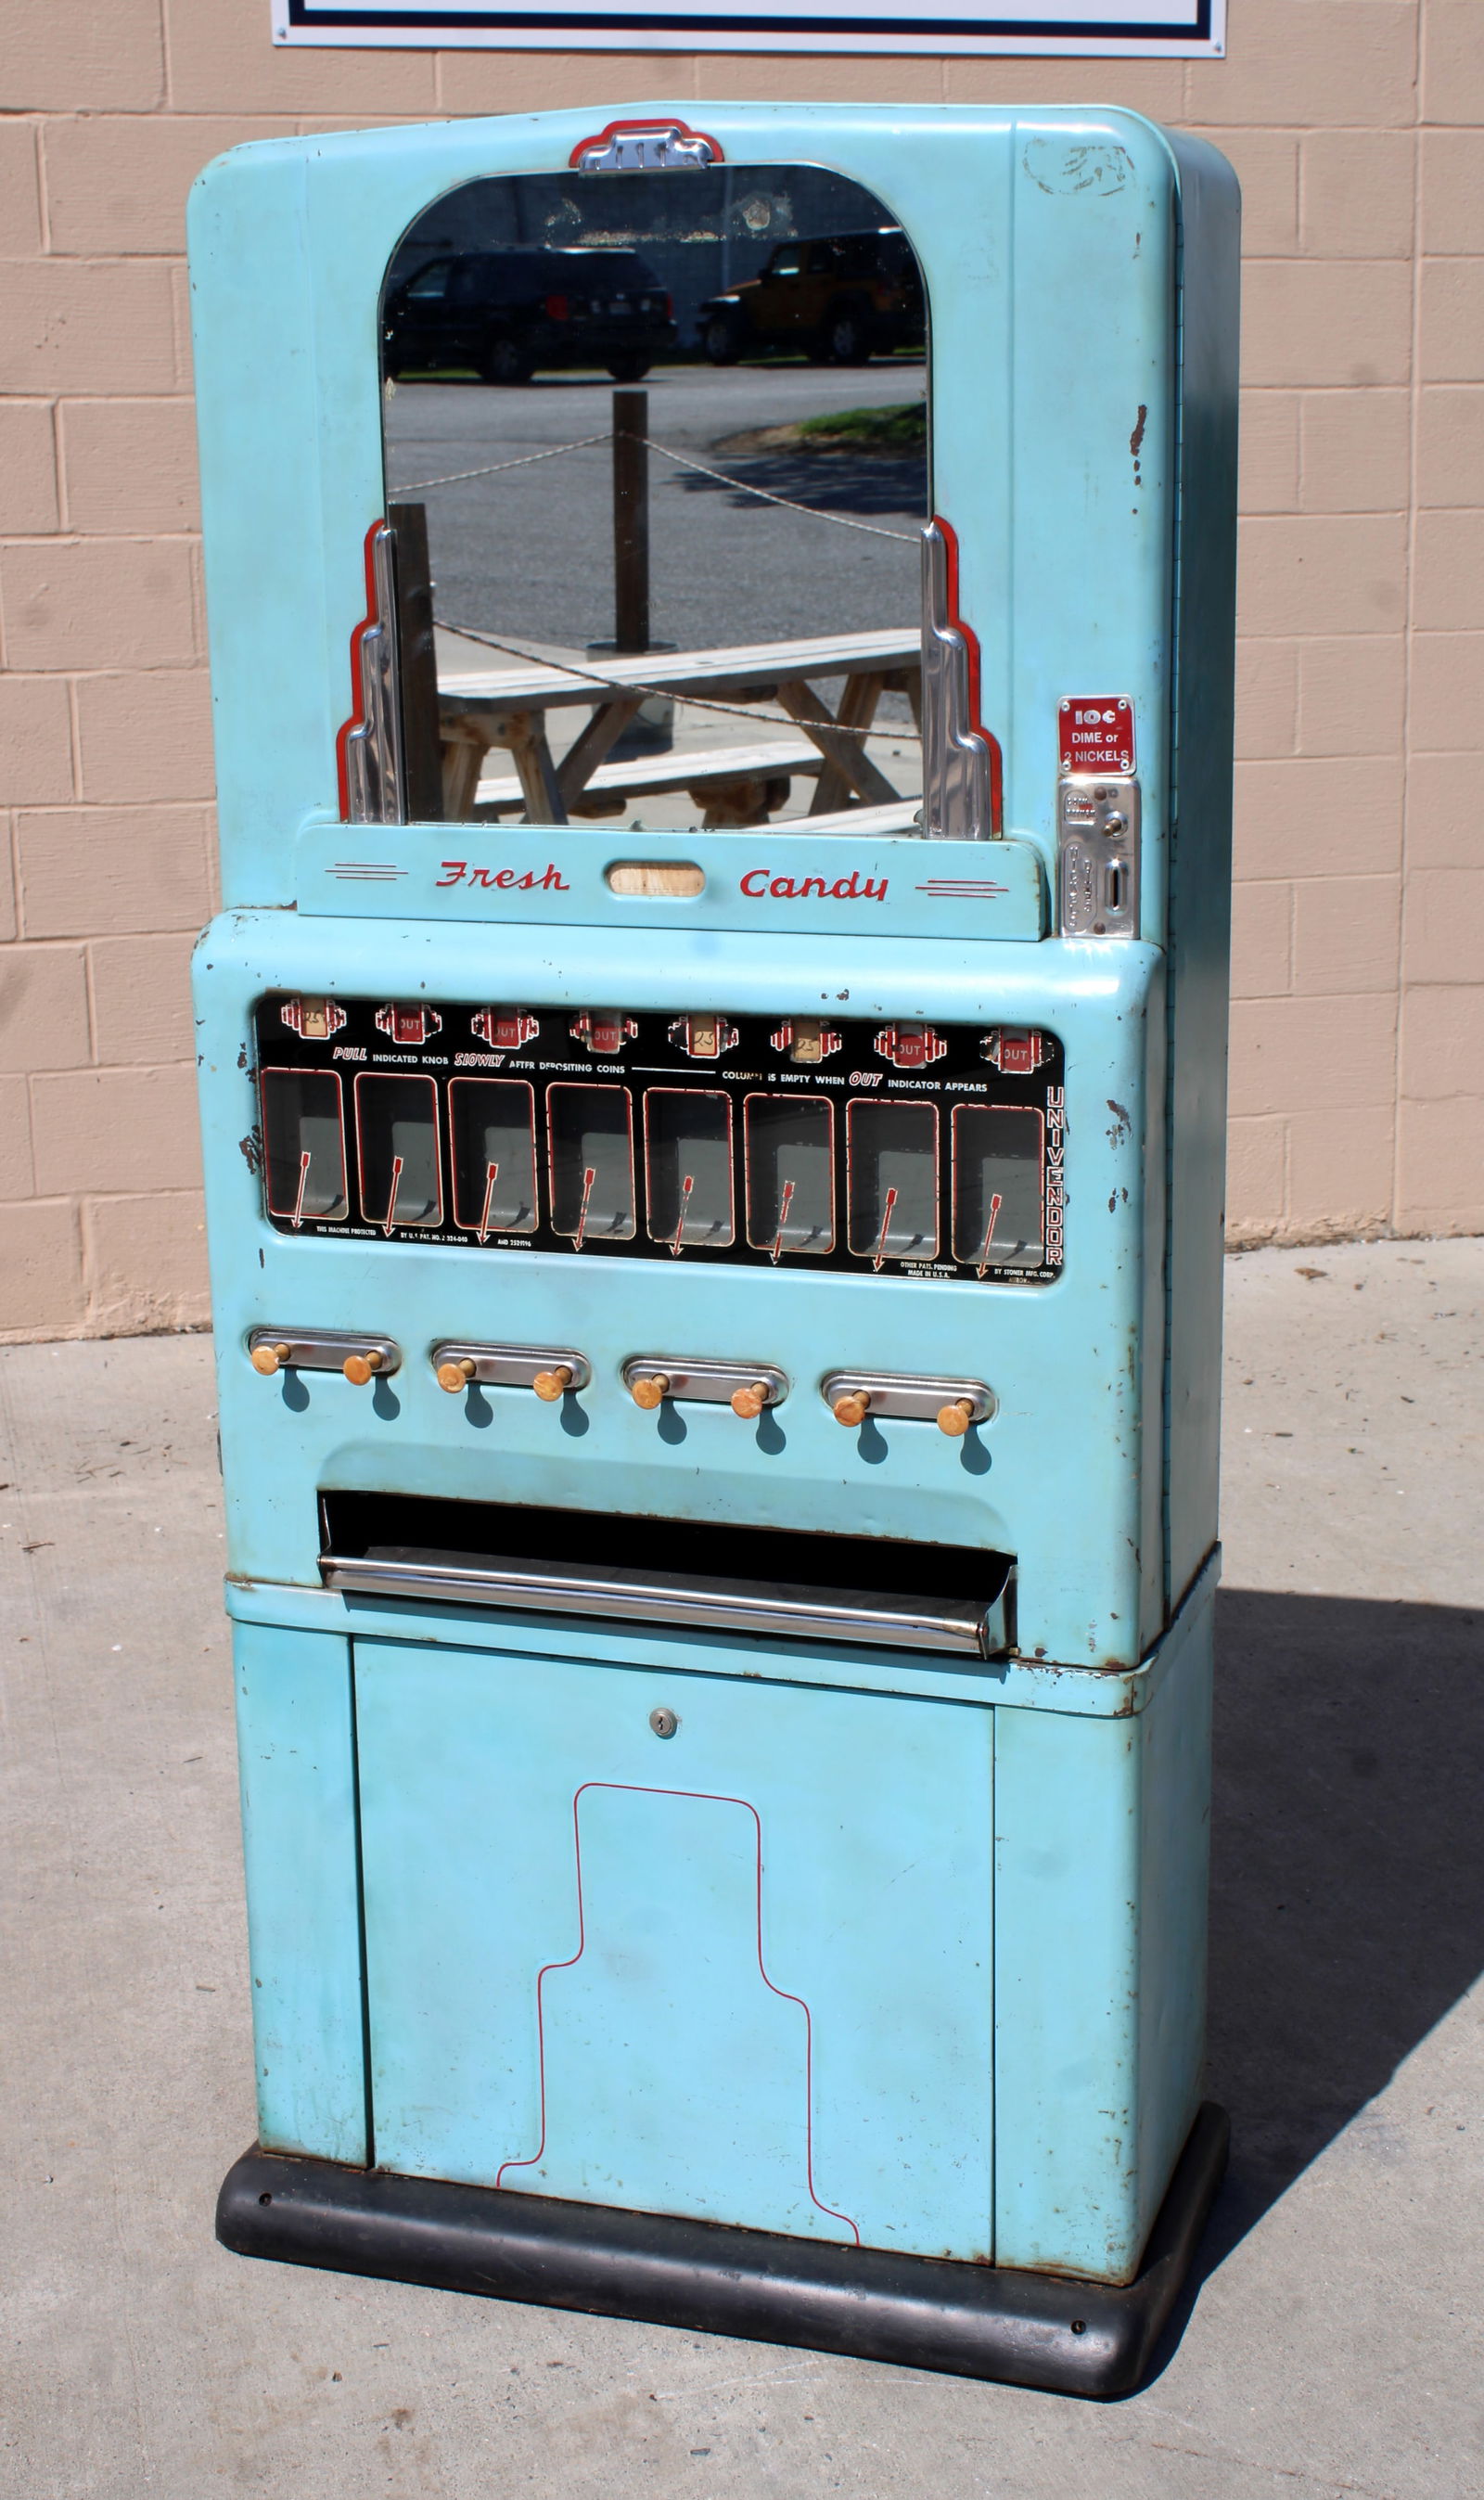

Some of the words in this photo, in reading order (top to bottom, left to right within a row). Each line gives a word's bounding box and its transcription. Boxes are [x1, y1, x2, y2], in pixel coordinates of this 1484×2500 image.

[1071, 732, 1103, 743] DIME
[1106, 735, 1119, 743] or
[1064, 751, 1072, 762] 2
[1075, 750, 1129, 762] NICKELS
[435, 861, 570, 891] Fresh
[740, 868, 889, 902] Candy
[401, 1019, 420, 1030] OUT
[595, 1031, 615, 1041] OUT
[900, 1044, 921, 1056] OUT
[1004, 1050, 1028, 1061] OUT
[332, 1046, 367, 1061] PULL
[373, 1054, 418, 1063] INDICATED
[422, 1056, 449, 1065] KNOB
[454, 1052, 505, 1068] SLOWLY
[596, 1065, 625, 1074] COINS
[768, 1073, 776, 1082] IS
[780, 1073, 811, 1083] EMPTY
[814, 1075, 845, 1085] WHEN
[849, 1071, 883, 1087] OUT
[888, 1079, 941, 1090] INDICATOR
[944, 1082, 988, 1093] APPEARS
[1046, 1085, 1064, 1265] UNIVENDOR
[933, 1263, 957, 1272] PENDING
[1040, 1271, 1055, 1279] CORP.
